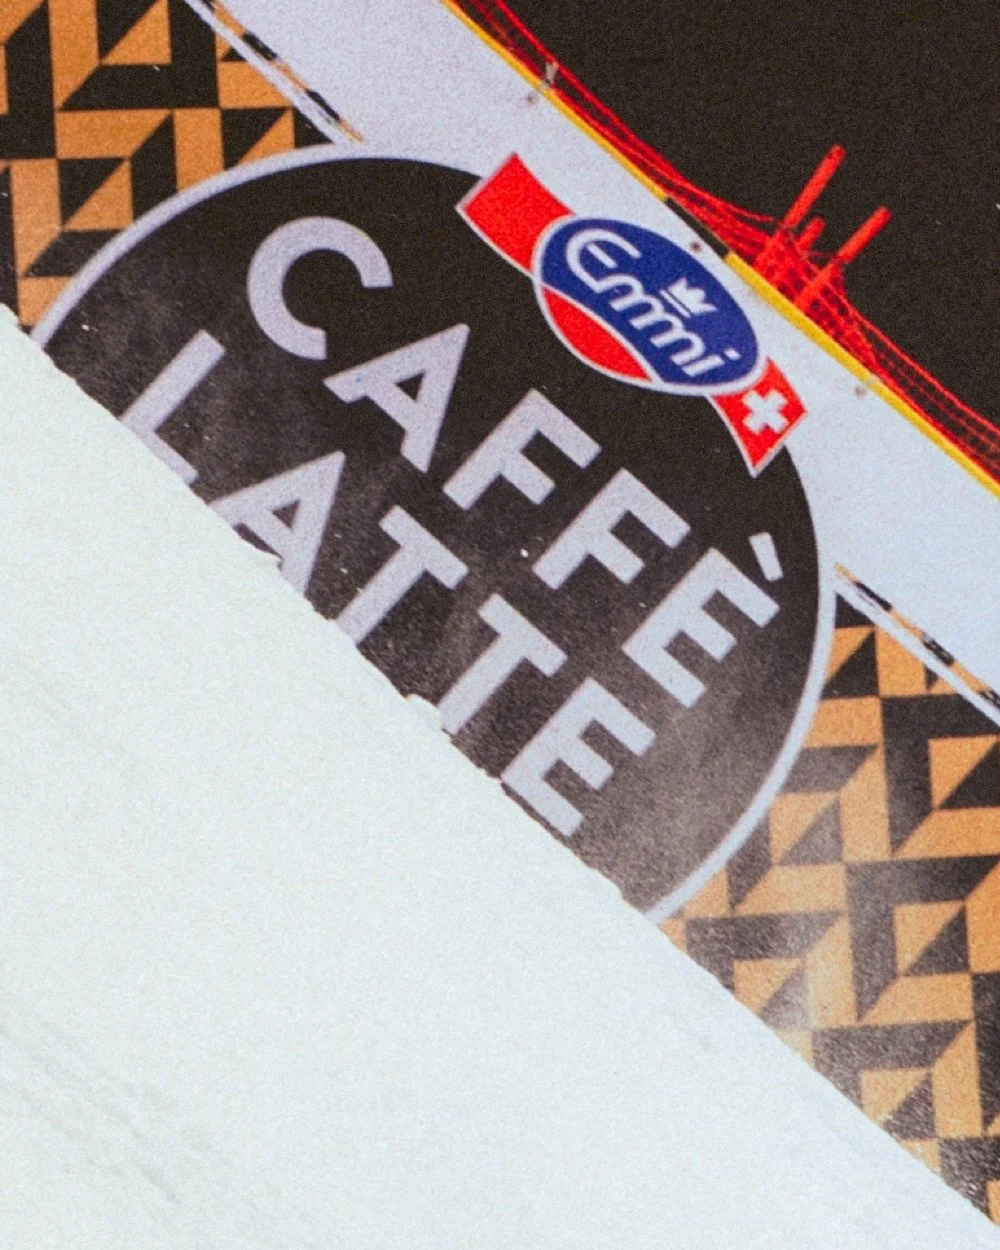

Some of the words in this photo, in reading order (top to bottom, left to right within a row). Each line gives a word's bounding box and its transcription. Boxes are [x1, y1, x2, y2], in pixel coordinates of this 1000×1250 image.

[247, 216, 784, 709] CAFFÈ
[565, 227, 741, 378] Emmi
[117, 329, 658, 838] LATTE
